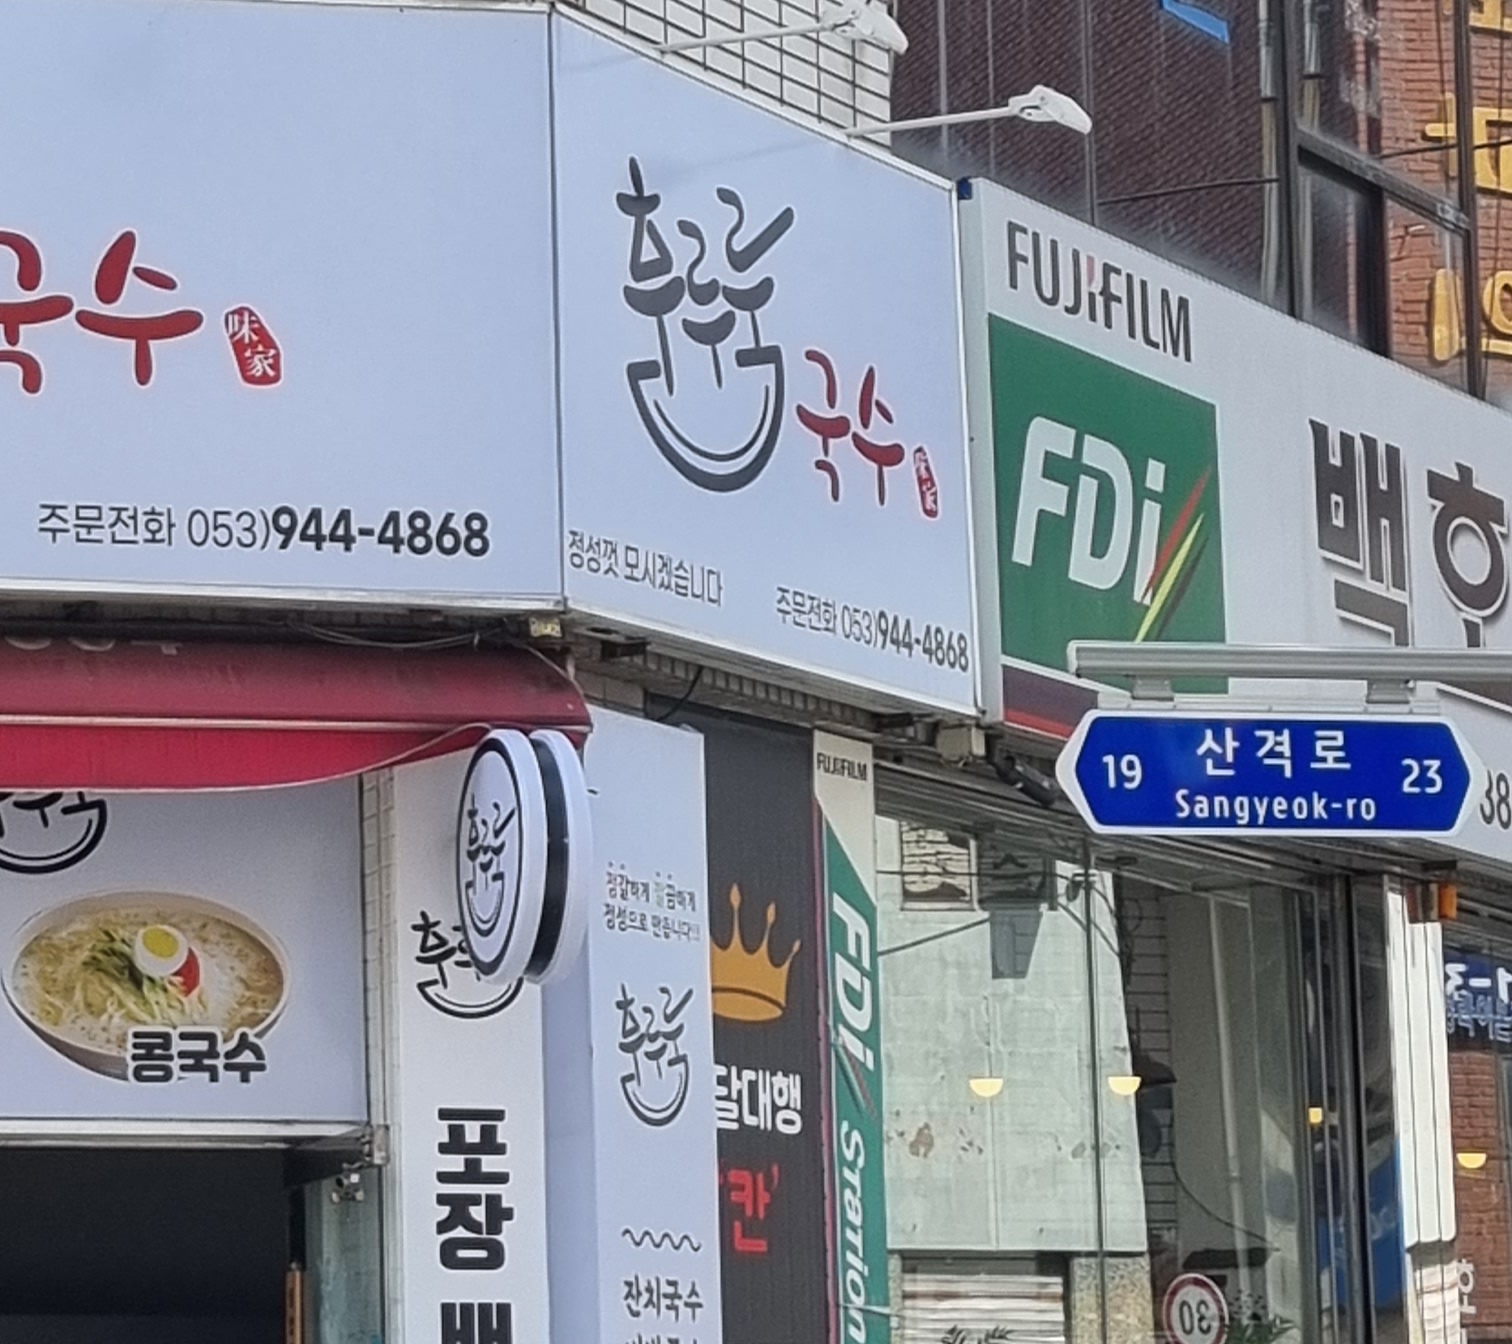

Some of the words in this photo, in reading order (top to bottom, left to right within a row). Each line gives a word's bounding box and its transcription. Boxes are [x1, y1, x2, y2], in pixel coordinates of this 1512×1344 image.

[1006, 220, 1193, 365] FUJIFILM
[616, 157, 794, 493] 후루룩
[796, 349, 905, 507] 국수
[38, 503, 176, 548] 주문전화
[188, 504, 491, 558] 053)944-4868
[567, 530, 620, 578] 정성껏
[624, 543, 724, 608] 모시겠습니다
[775, 585, 837, 635] 주문전화
[1103, 754, 1143, 789] 19
[1195, 728, 1353, 778] 산격로
[1401, 757, 1443, 794] 23
[1175, 789, 1378, 827] Sangyeok-ro
[128, 1028, 268, 1084] 콩국수
[616, 982, 694, 1128] 후루룩
[435, 1107, 515, 1271] 포장
[622, 1274, 705, 1323] 잔치국수
